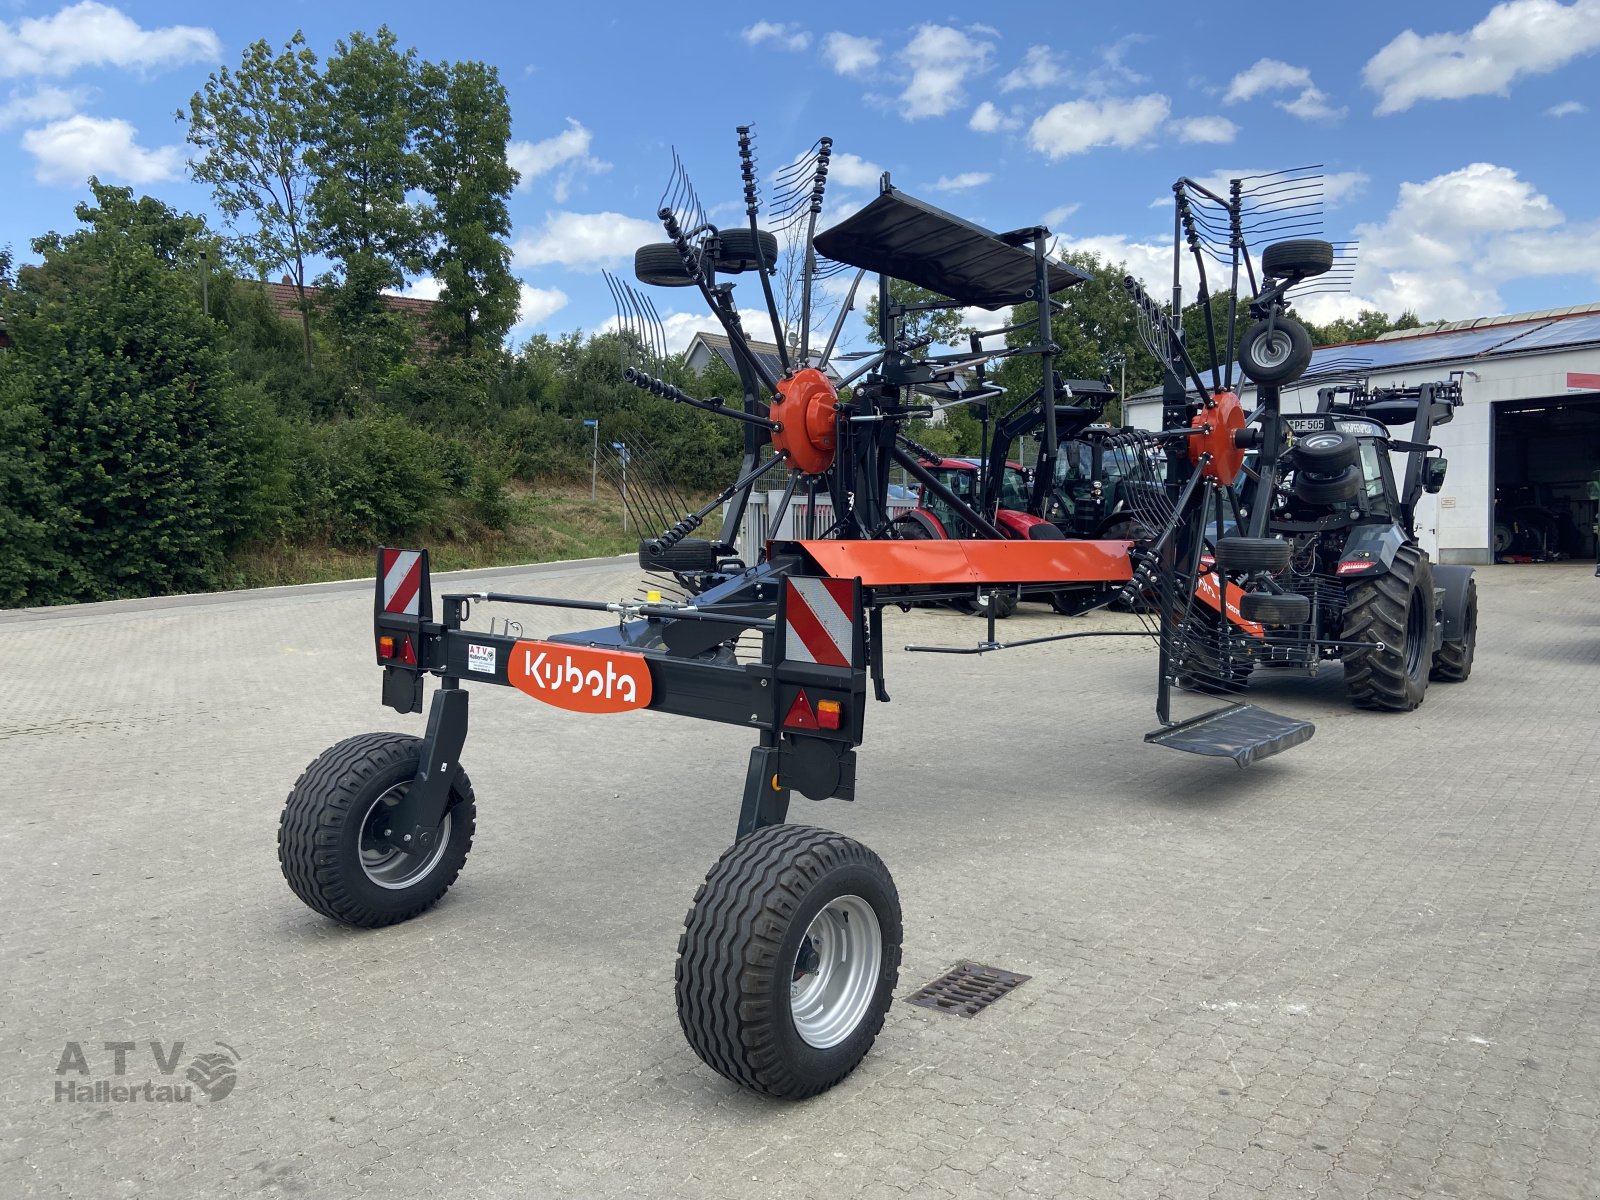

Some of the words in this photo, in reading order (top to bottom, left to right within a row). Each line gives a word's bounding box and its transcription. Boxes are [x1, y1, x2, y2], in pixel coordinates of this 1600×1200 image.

[1307, 420, 1324, 430] 505
[469, 645, 488, 656] ATV
[524, 650, 637, 703] Kubota
